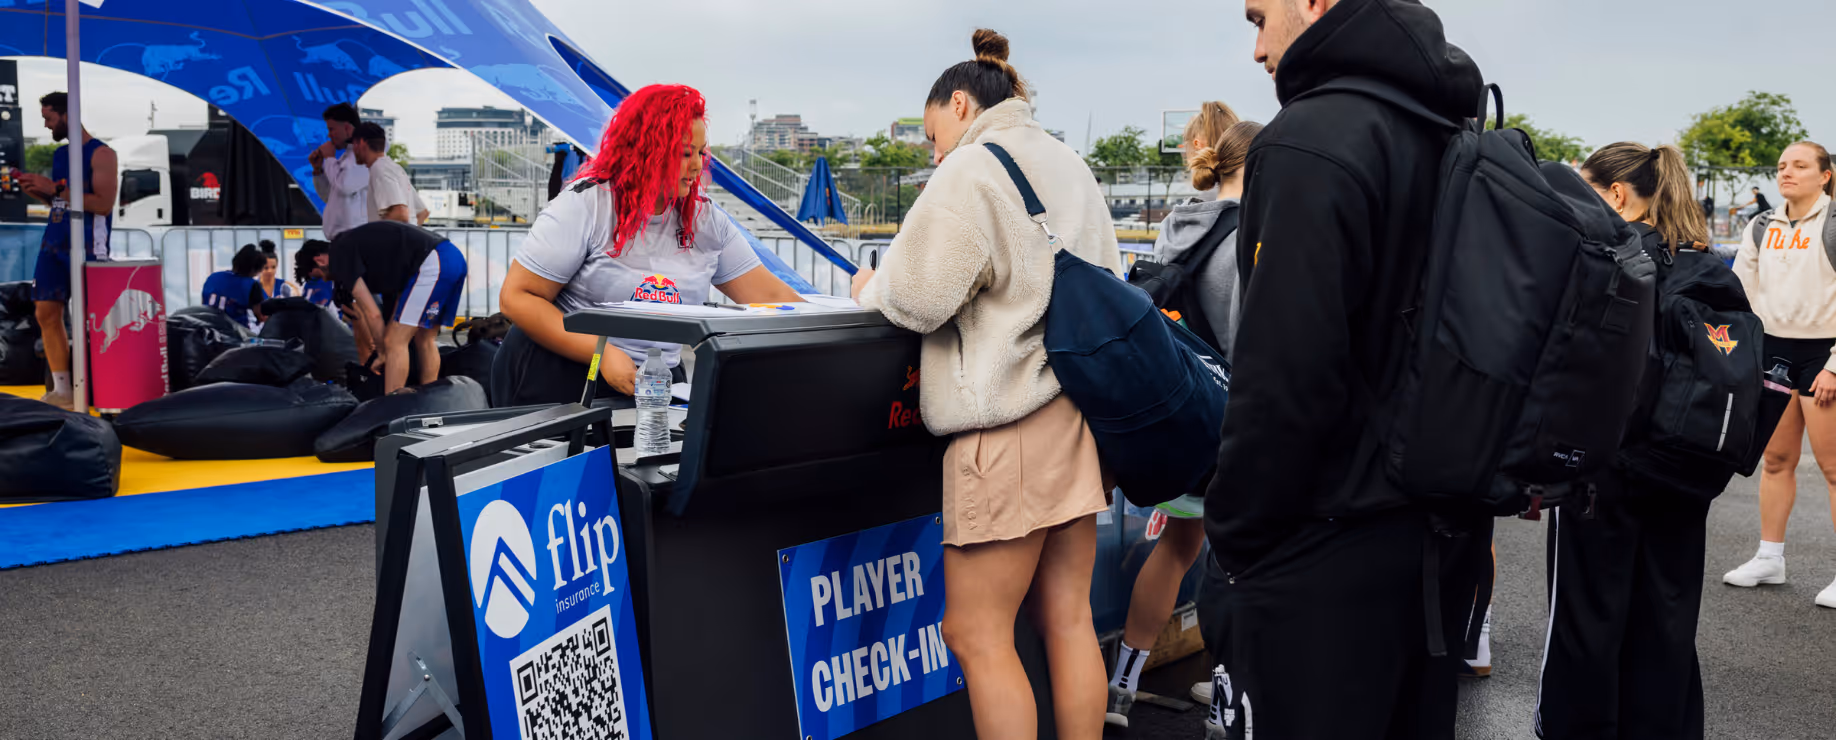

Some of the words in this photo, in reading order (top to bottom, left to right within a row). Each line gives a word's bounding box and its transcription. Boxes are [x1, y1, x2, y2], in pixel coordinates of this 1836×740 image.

[634, 287, 657, 301] Red
[658, 290, 680, 304] Bull
[546, 499, 619, 596] flip
[555, 581, 600, 614] insurance
[810, 551, 924, 627] PLAYER
[811, 621, 949, 712] CHECK-IN
